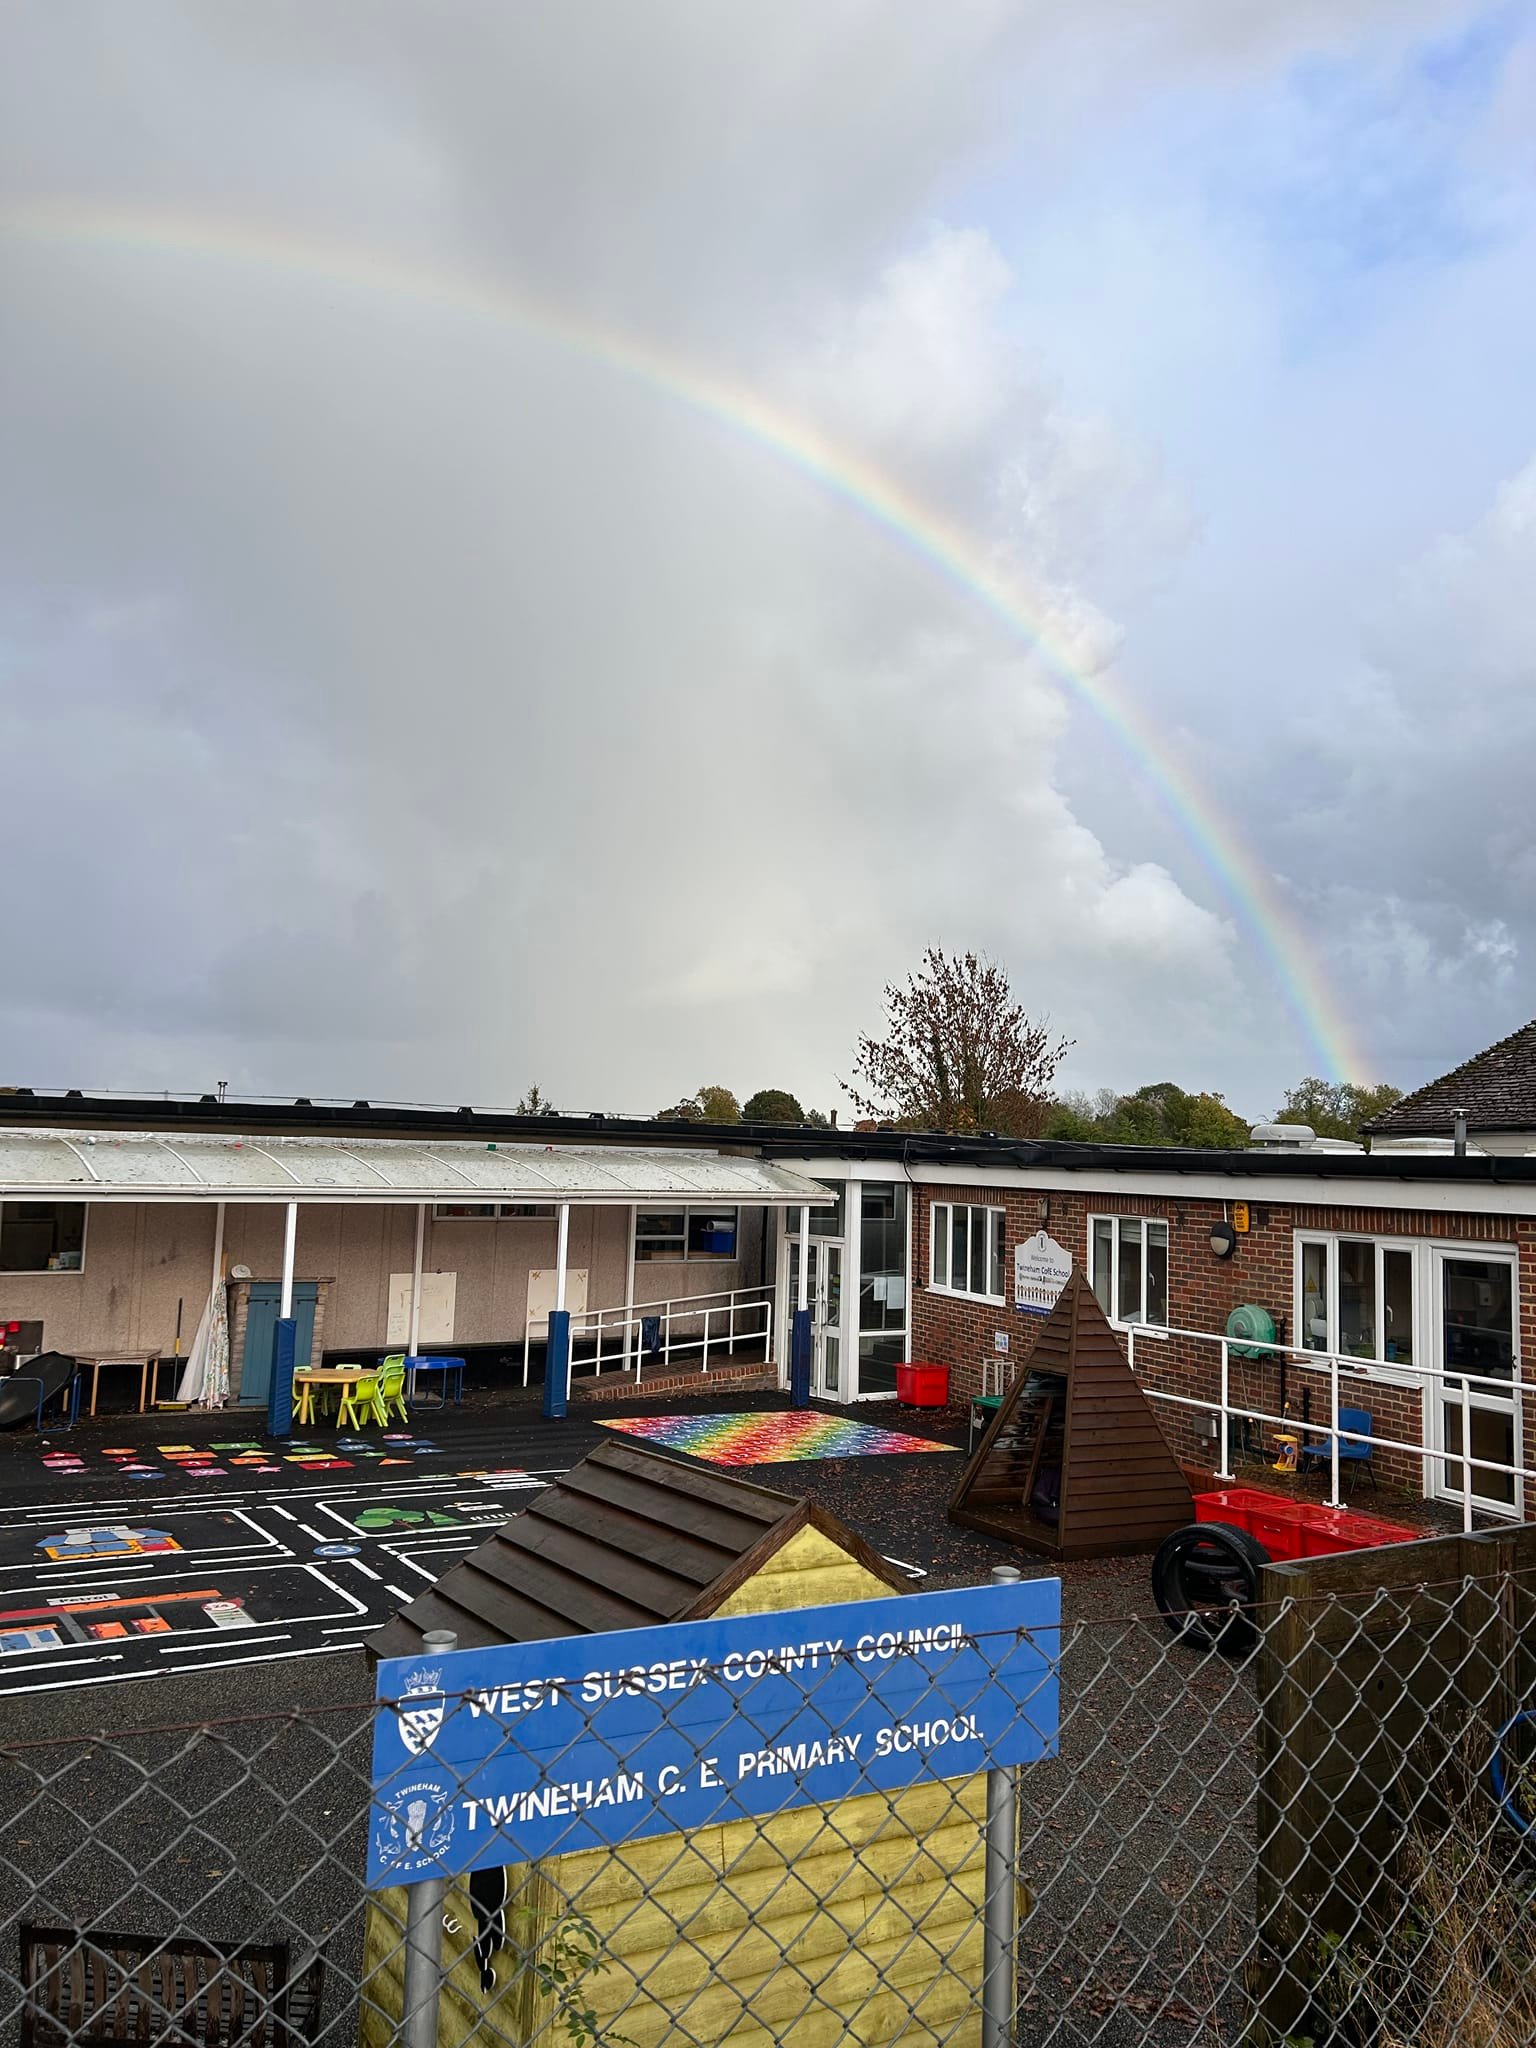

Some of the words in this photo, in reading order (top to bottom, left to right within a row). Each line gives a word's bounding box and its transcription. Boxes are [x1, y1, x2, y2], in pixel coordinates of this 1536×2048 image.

[1016, 1262, 1041, 1274] Twineham
[468, 1676, 567, 1718] WEST
[581, 1657, 709, 1703] SUSSEX
[722, 1639, 844, 1682] COUNTY
[856, 1623, 970, 1663] COUNCIL
[462, 1771, 644, 1831] TWINEHAM
[658, 1765, 687, 1796] C.
[700, 1757, 727, 1788] E.
[738, 1733, 863, 1780] PRIMARY
[874, 1714, 985, 1757] SCHOOL
[395, 1783, 440, 1799] TWINEHAM
[404, 1862, 413, 1870] E.
[416, 1844, 450, 1868] SCHOOL
